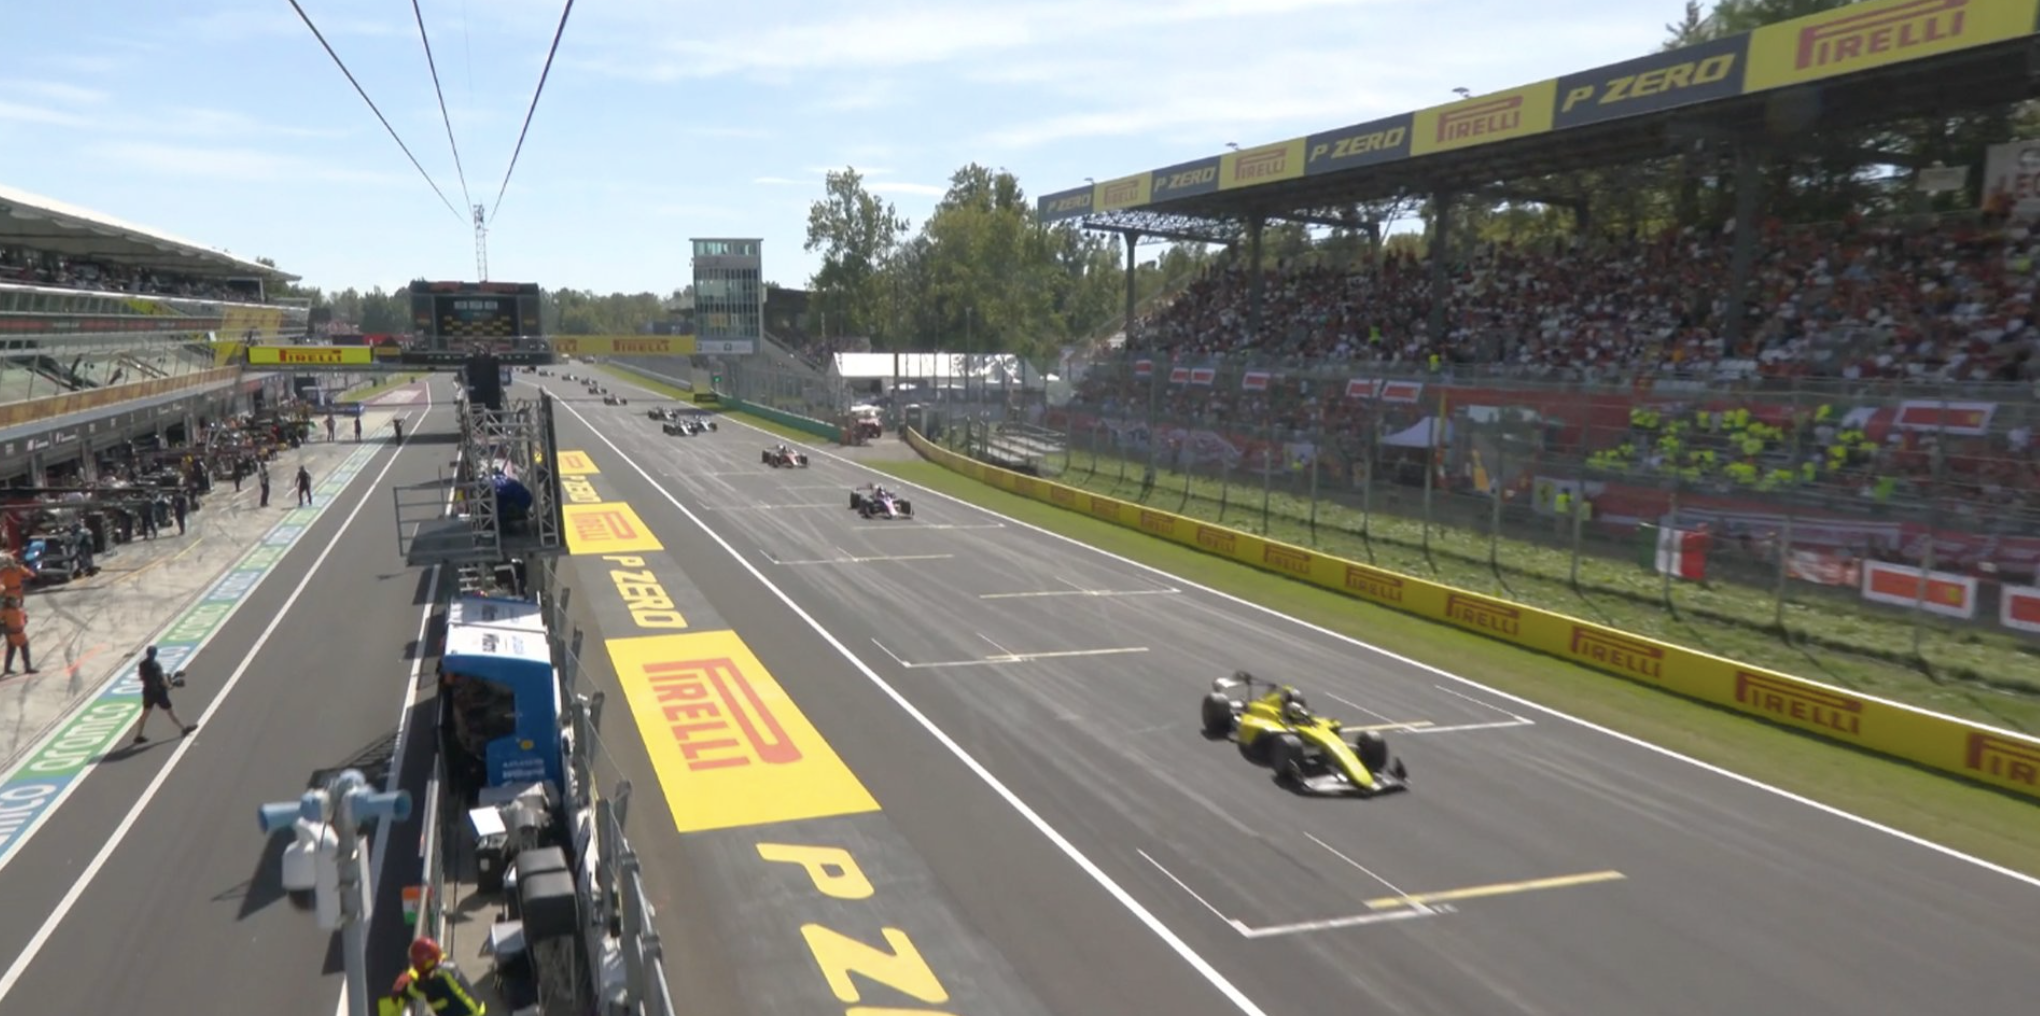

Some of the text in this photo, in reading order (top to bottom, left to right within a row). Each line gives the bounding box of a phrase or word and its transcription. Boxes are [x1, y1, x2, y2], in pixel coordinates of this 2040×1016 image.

[1796, 0, 1969, 71] PIRELLI
[1562, 53, 1735, 112] P ZERO
[1436, 95, 1523, 142] PIRELLI
[1234, 148, 1287, 181] PIRELLI
[1308, 126, 1406, 163] P ZERO
[1057, 193, 1092, 211] ZERO
[1104, 180, 1140, 206] PIRELLI
[1154, 166, 1217, 192] P ZERO
[279, 349, 342, 362] PIRELLI
[602, 556, 688, 628] P ZERO
[1346, 564, 1403, 601] PIRELLI
[1446, 592, 1520, 636] PIRELLI
[1570, 625, 1664, 678] PIRELLI
[642, 657, 804, 772] PIRELLI
[1735, 671, 1864, 735] PIRELLI
[30, 703, 136, 771] aramco
[755, 843, 875, 900] P
